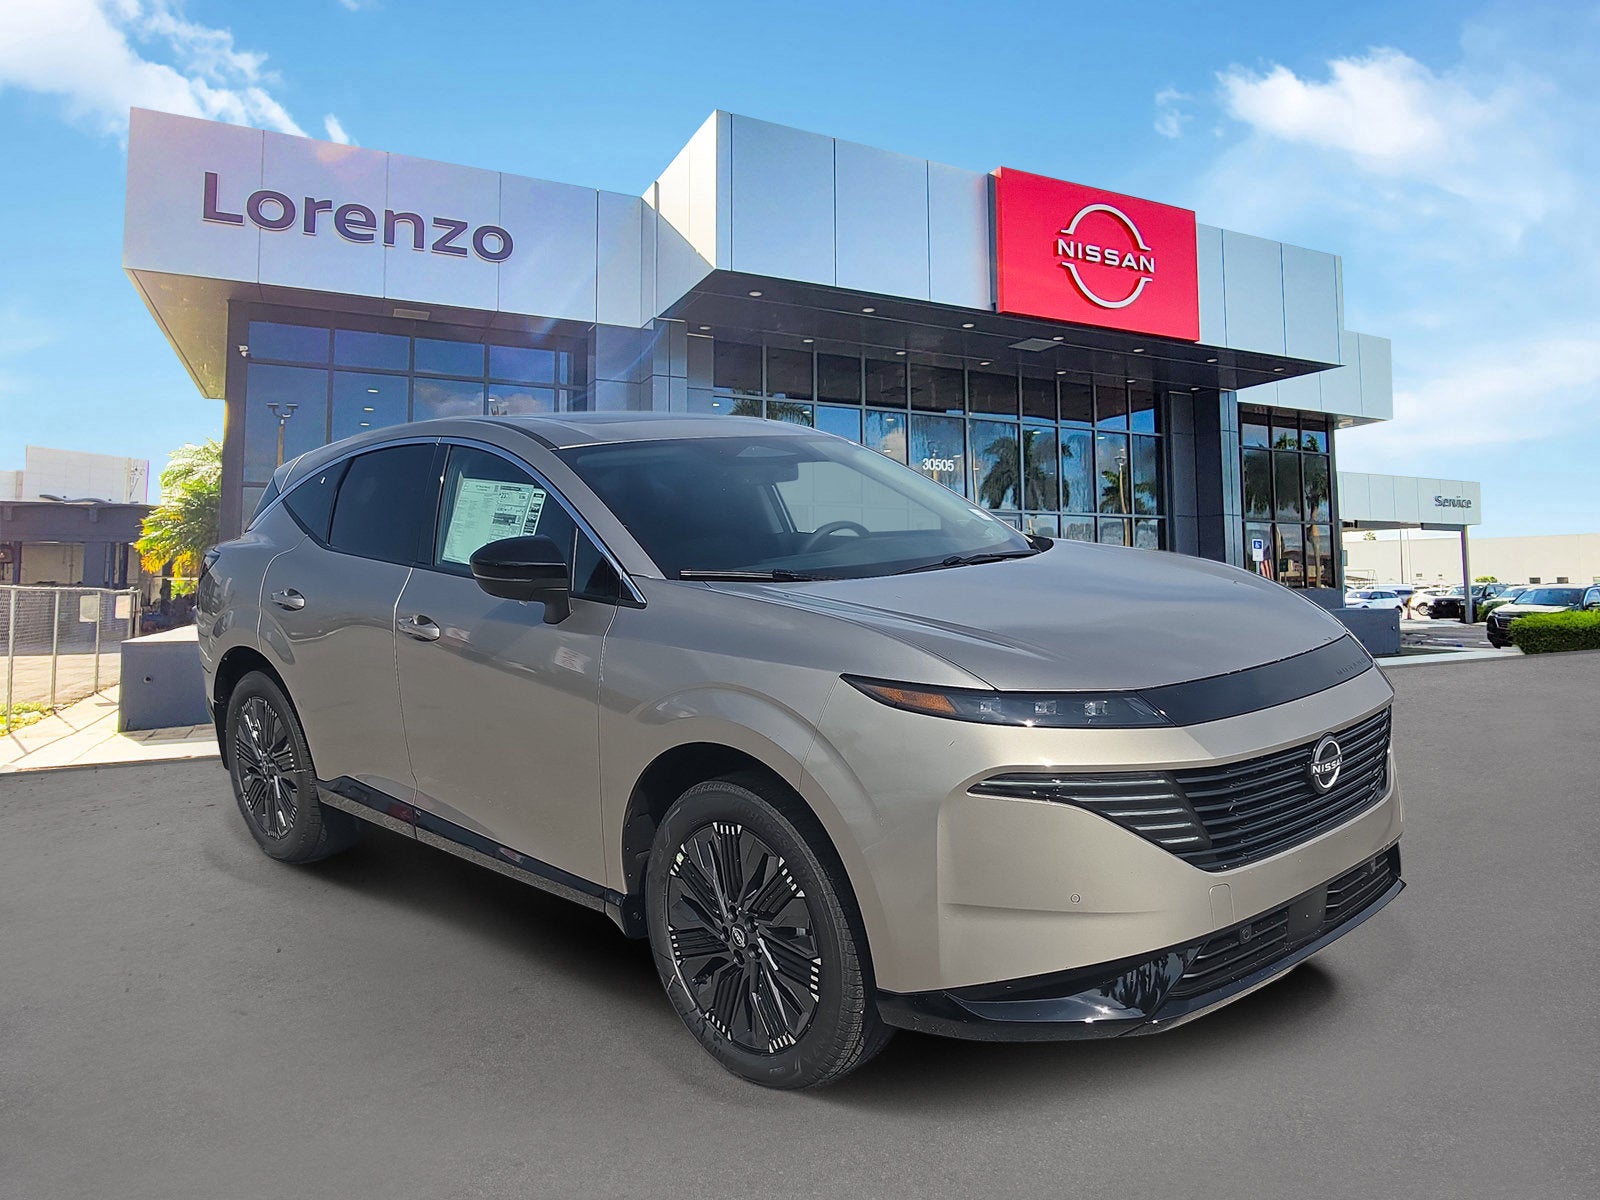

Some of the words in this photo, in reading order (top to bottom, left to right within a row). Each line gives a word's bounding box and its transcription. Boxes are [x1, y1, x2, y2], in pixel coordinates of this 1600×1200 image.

[202, 171, 515, 263] Lorenzo
[1057, 238, 1155, 273] NISSAN
[922, 458, 955, 472] 30505
[1434, 495, 1472, 509] Service
